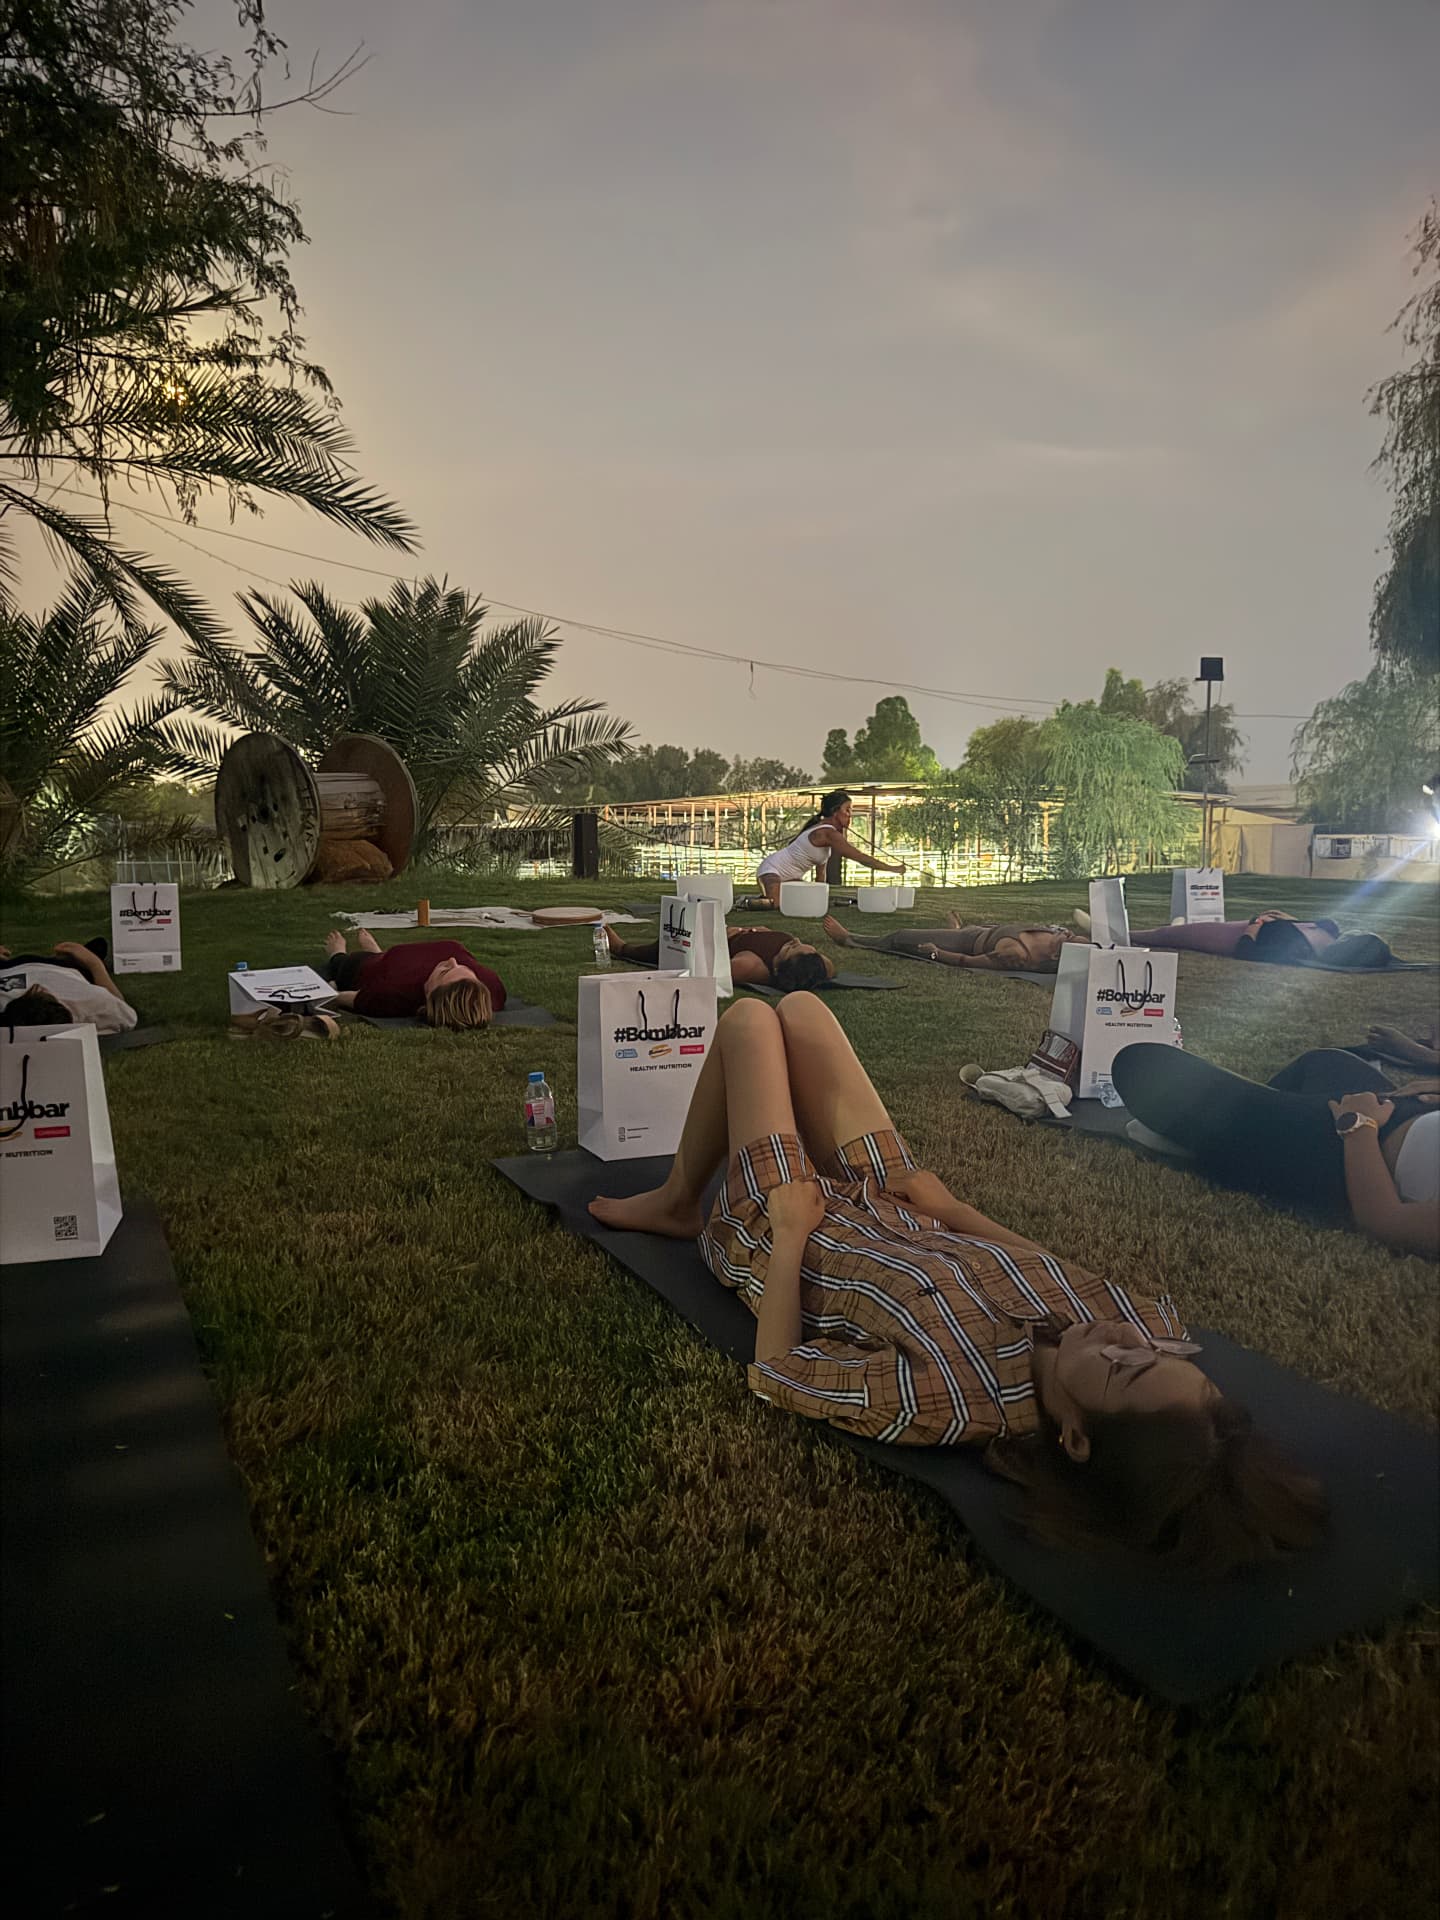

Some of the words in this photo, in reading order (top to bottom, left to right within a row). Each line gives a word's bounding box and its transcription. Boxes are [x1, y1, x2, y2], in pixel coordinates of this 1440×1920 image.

[1096, 988, 1166, 1004] #Bombbar
[614, 1024, 705, 1042] #Bombbar
[5, 1149, 53, 1158] NUTRITION
